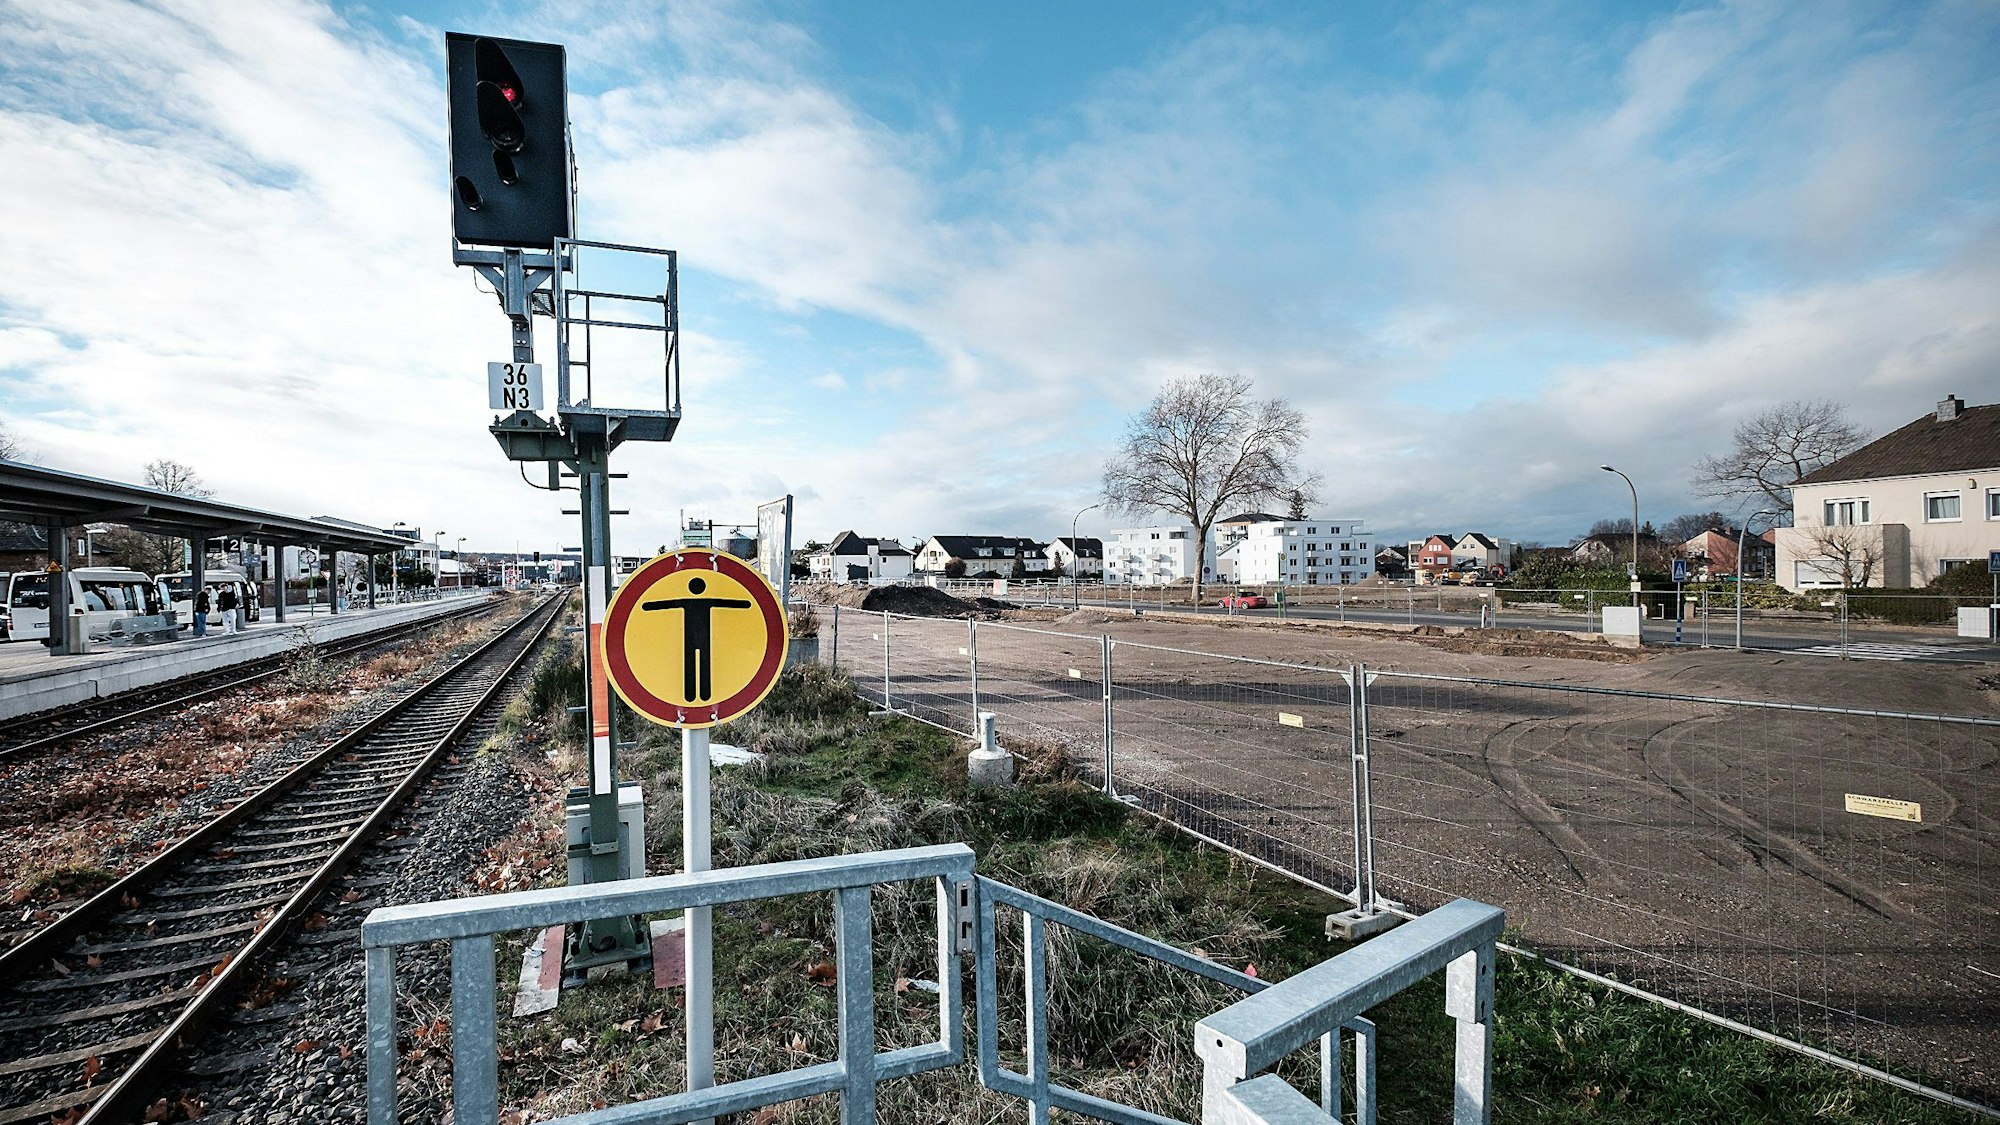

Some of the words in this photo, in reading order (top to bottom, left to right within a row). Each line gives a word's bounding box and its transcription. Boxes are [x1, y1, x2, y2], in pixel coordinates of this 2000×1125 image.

[503, 363, 528, 386] 36
[503, 387, 530, 409] N3
[230, 539, 240, 551] 2
